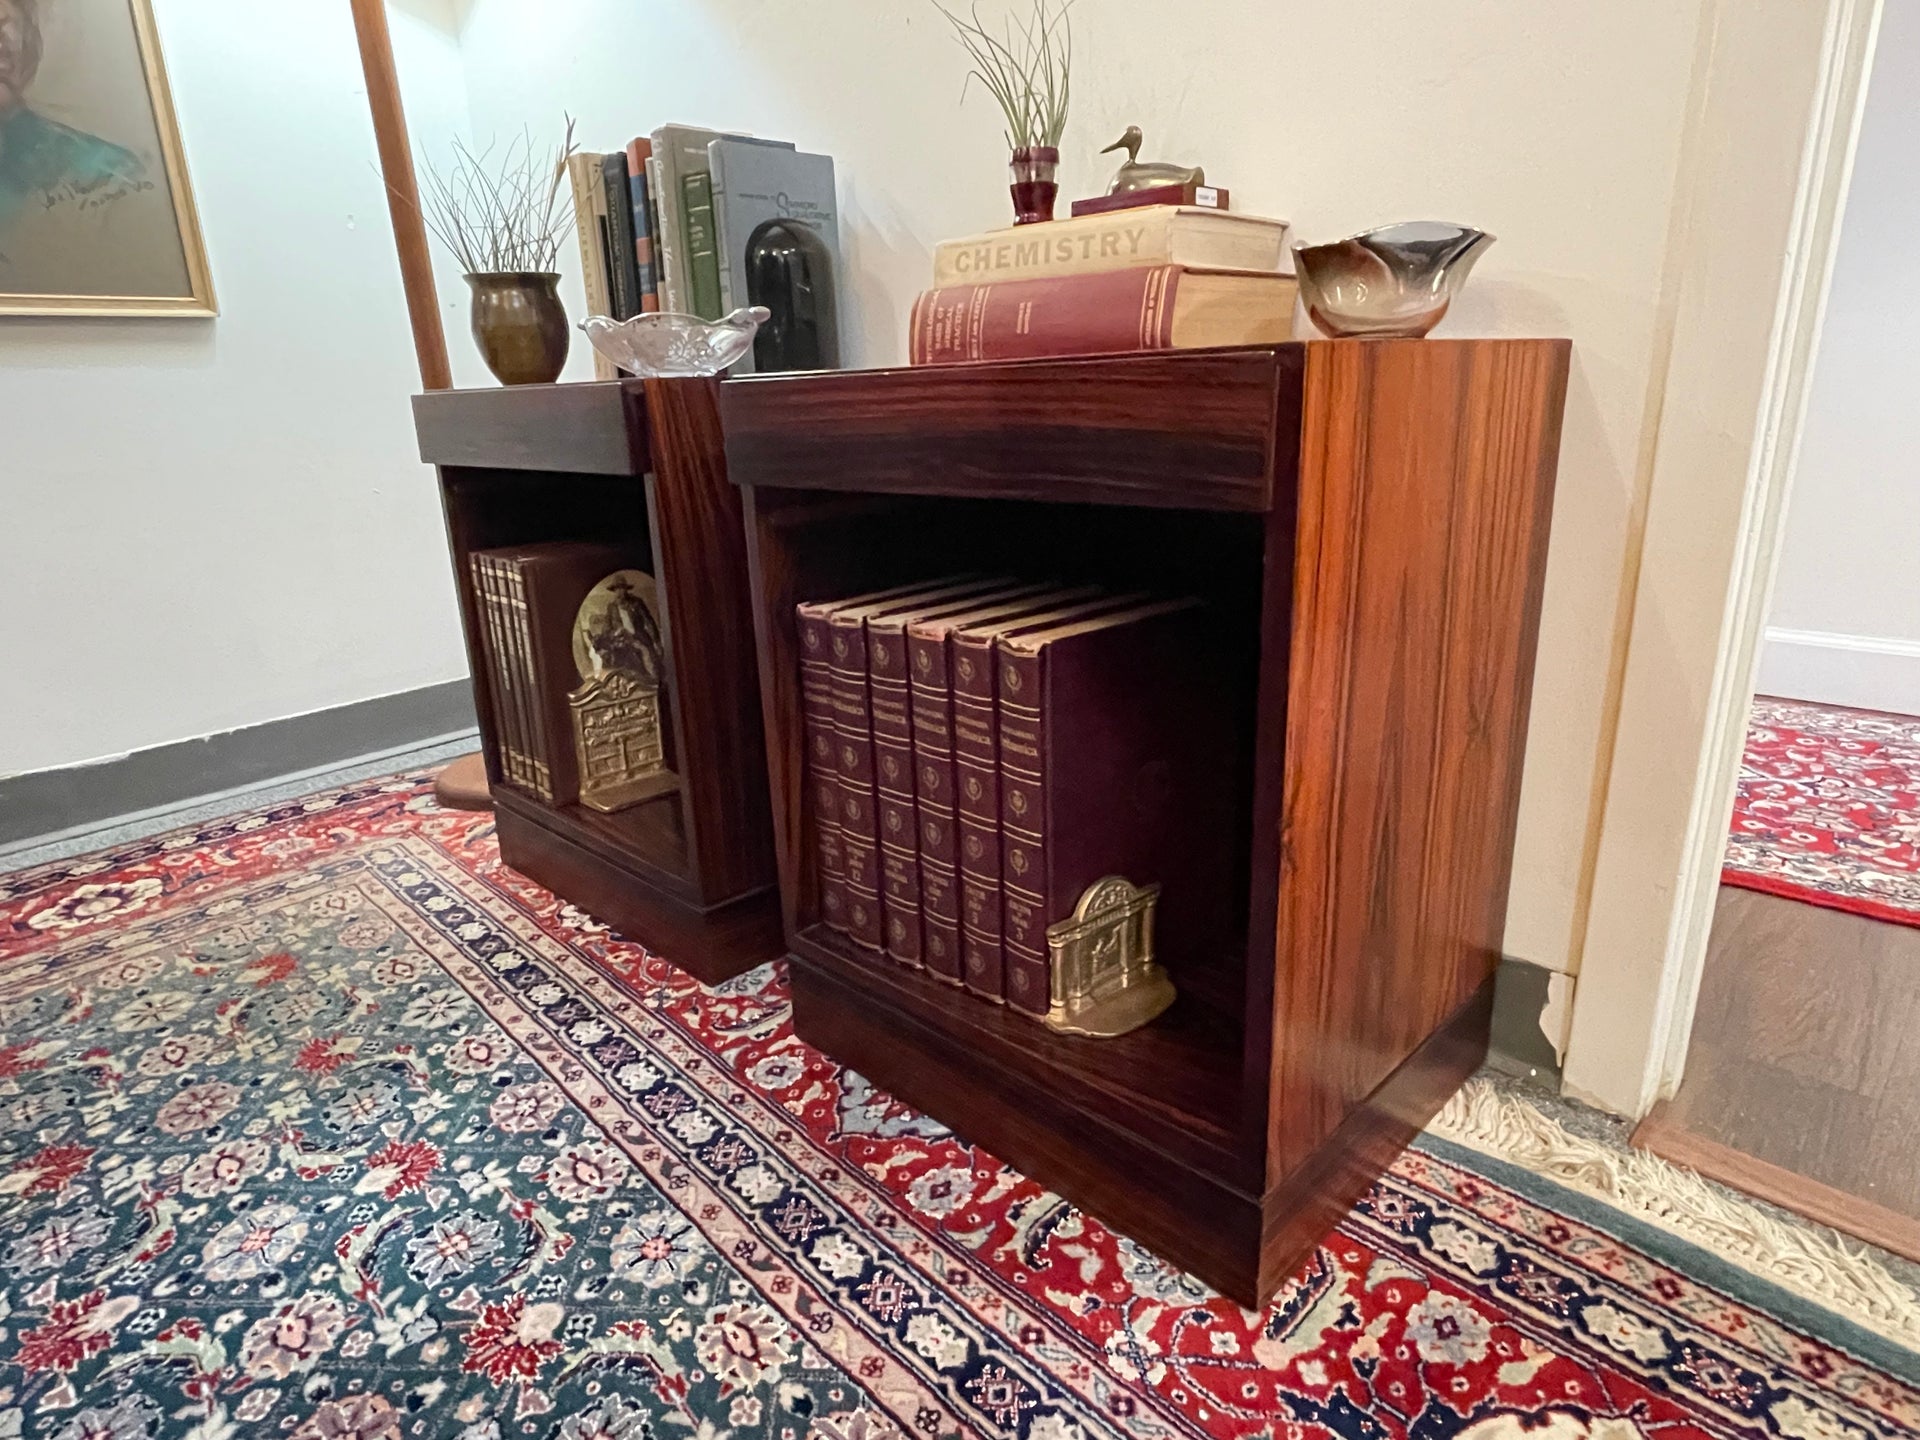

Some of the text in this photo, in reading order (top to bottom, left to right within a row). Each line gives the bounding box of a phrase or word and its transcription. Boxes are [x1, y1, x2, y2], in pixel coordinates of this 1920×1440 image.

[954, 228, 1145, 273] CHEMISTRY
[615, 261, 626, 319] CHEMISTR
[944, 306, 954, 349] MEDICAL
[954, 302, 964, 351] PRACTICE
[971, 338, 979, 359] BEST
